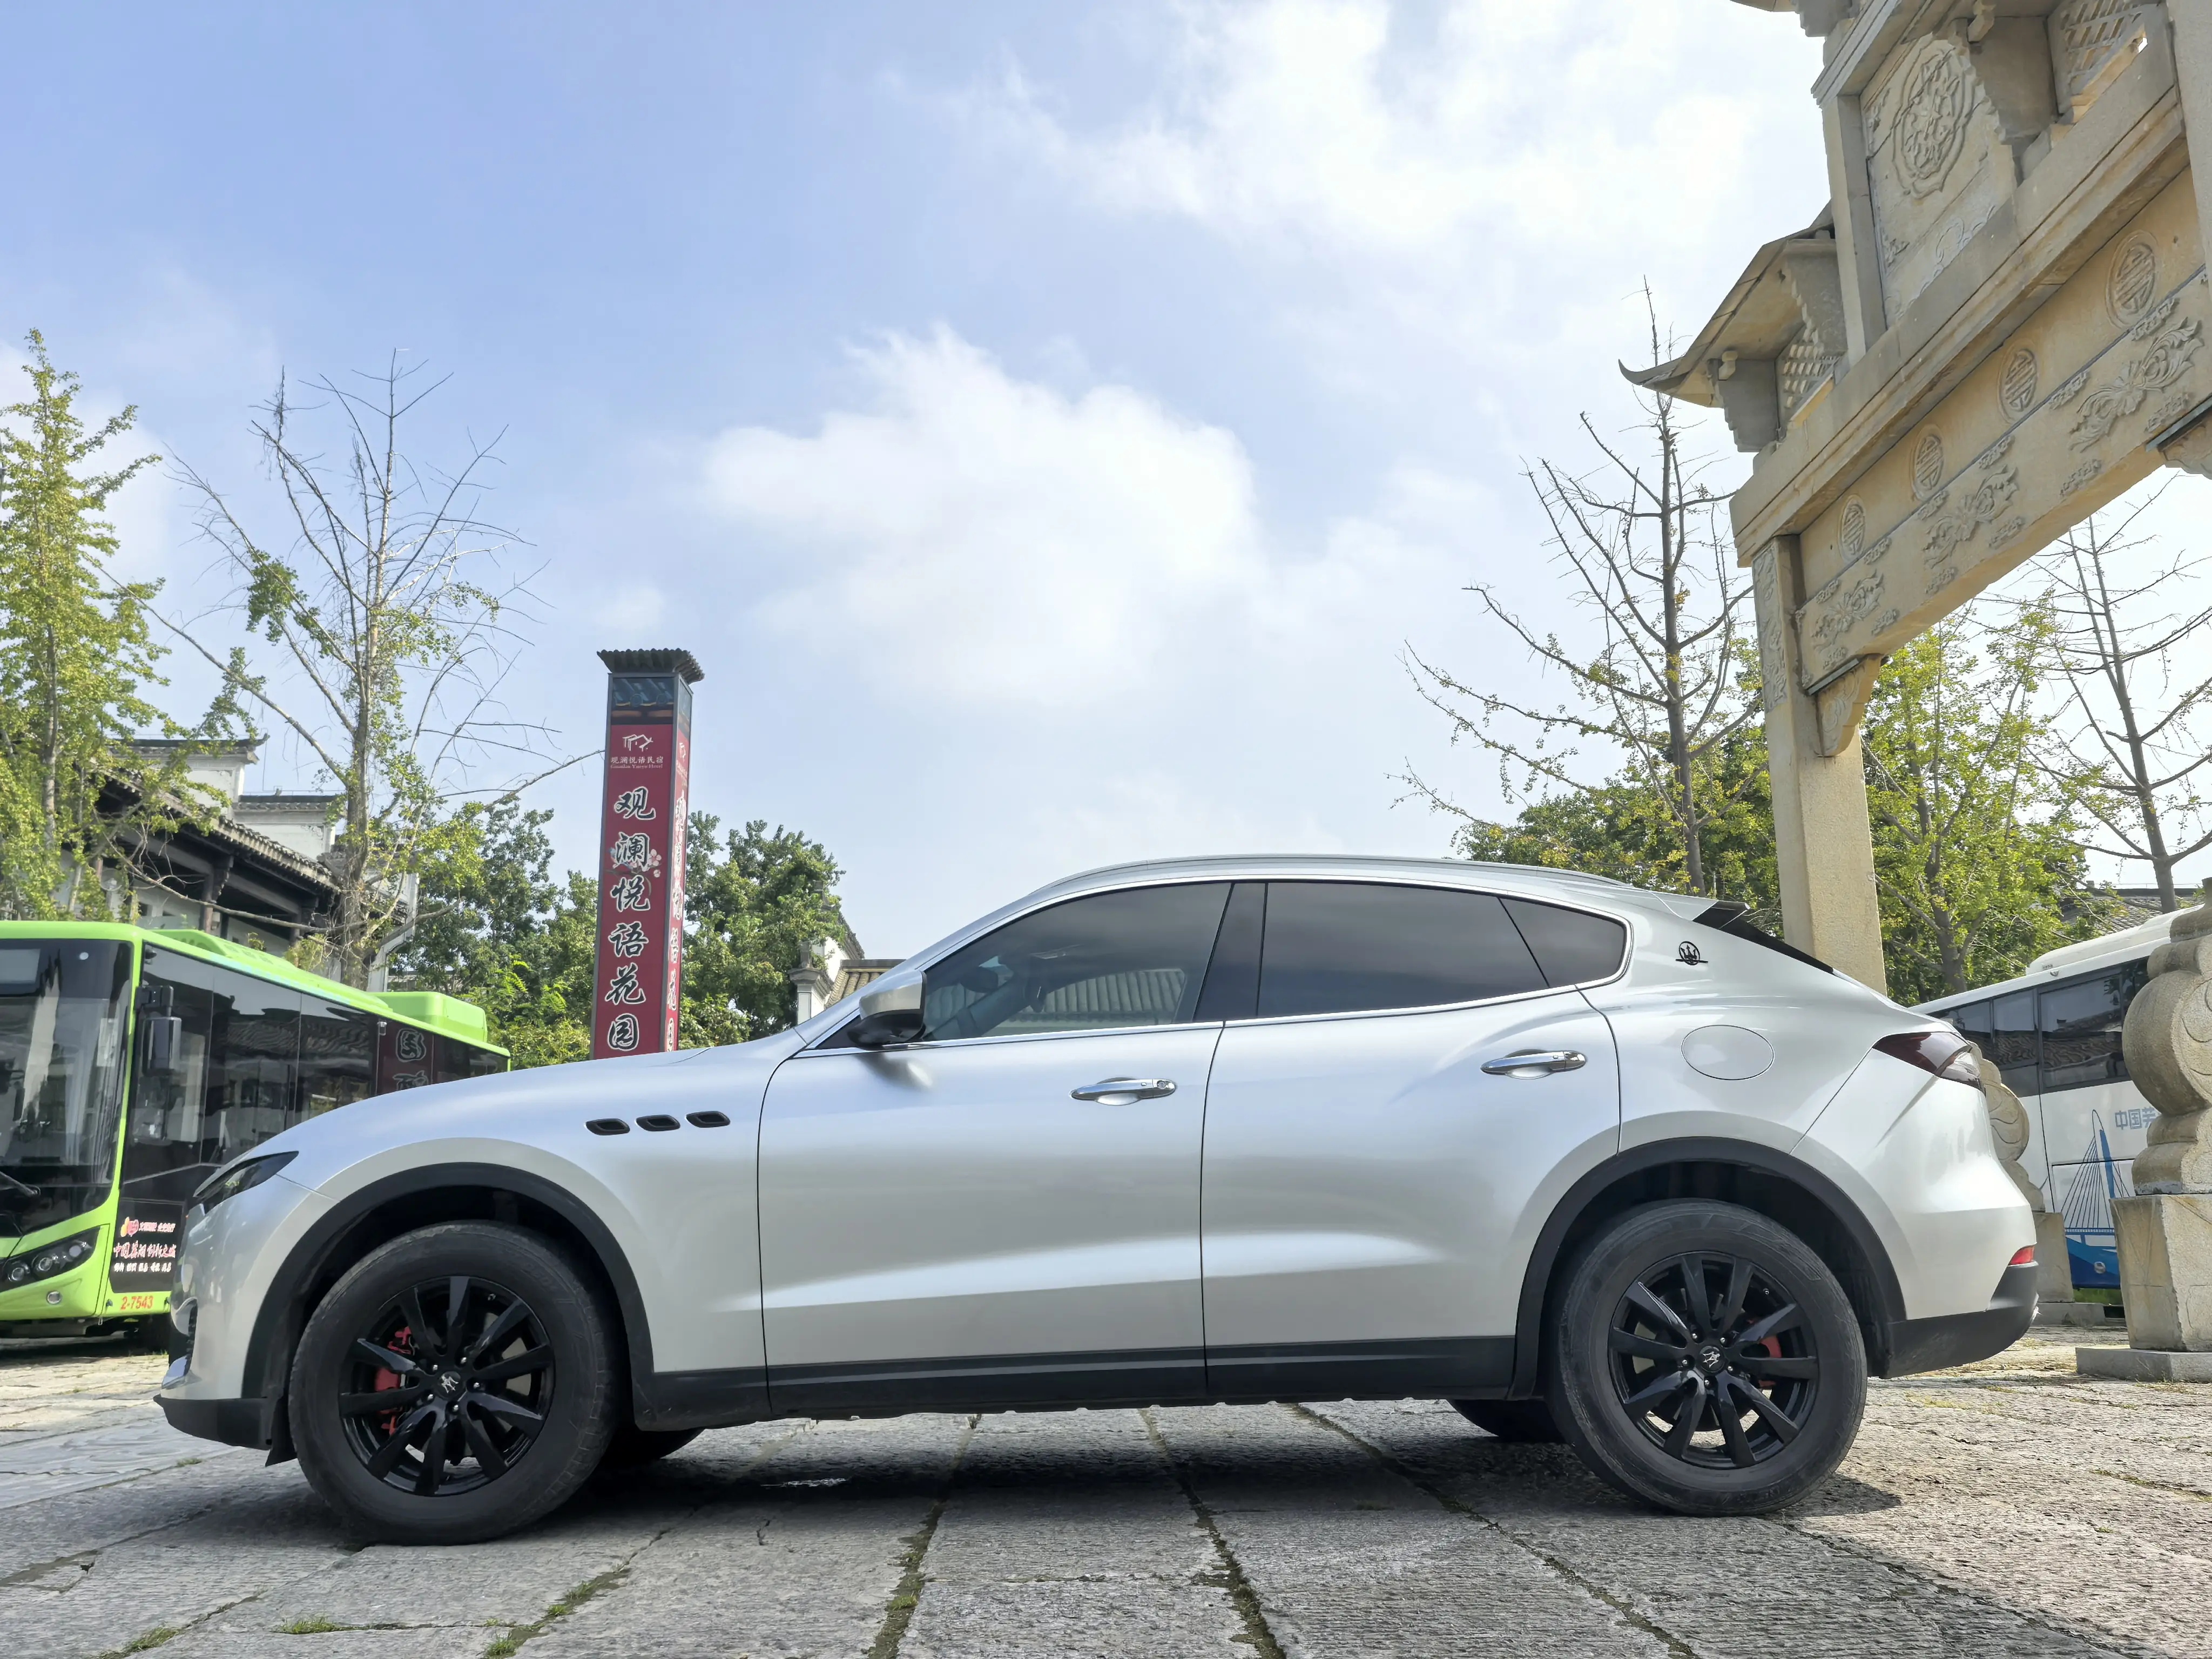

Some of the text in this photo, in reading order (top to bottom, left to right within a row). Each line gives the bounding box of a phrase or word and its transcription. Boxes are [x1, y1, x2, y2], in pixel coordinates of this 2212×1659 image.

[605, 786, 656, 1051] 观澜悦语花园
